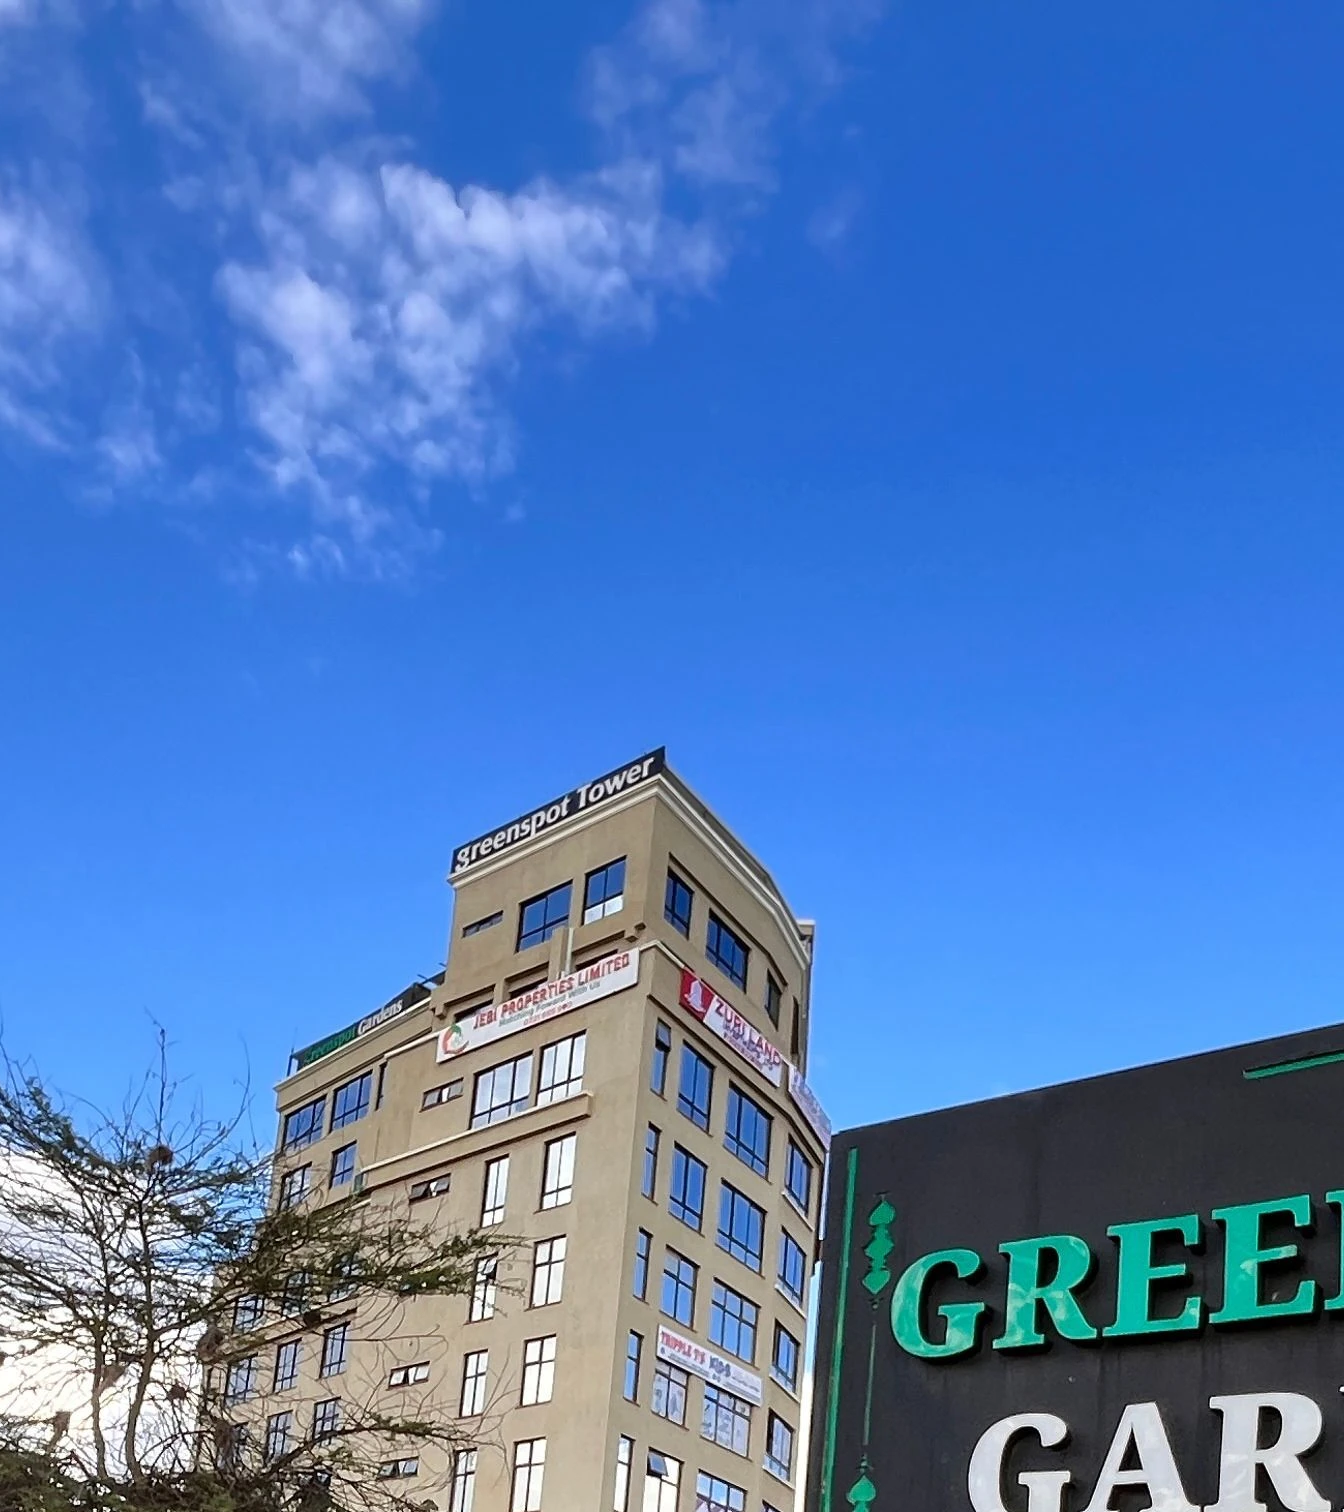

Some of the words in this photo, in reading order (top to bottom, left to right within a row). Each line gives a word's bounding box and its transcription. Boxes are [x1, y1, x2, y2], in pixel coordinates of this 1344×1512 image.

[576, 756, 655, 809] Tower
[357, 999, 404, 1036] Gardens
[472, 1008, 498, 1030] JEBI
[500, 977, 575, 1018] PROPERTIES
[577, 952, 631, 989] LIMITED
